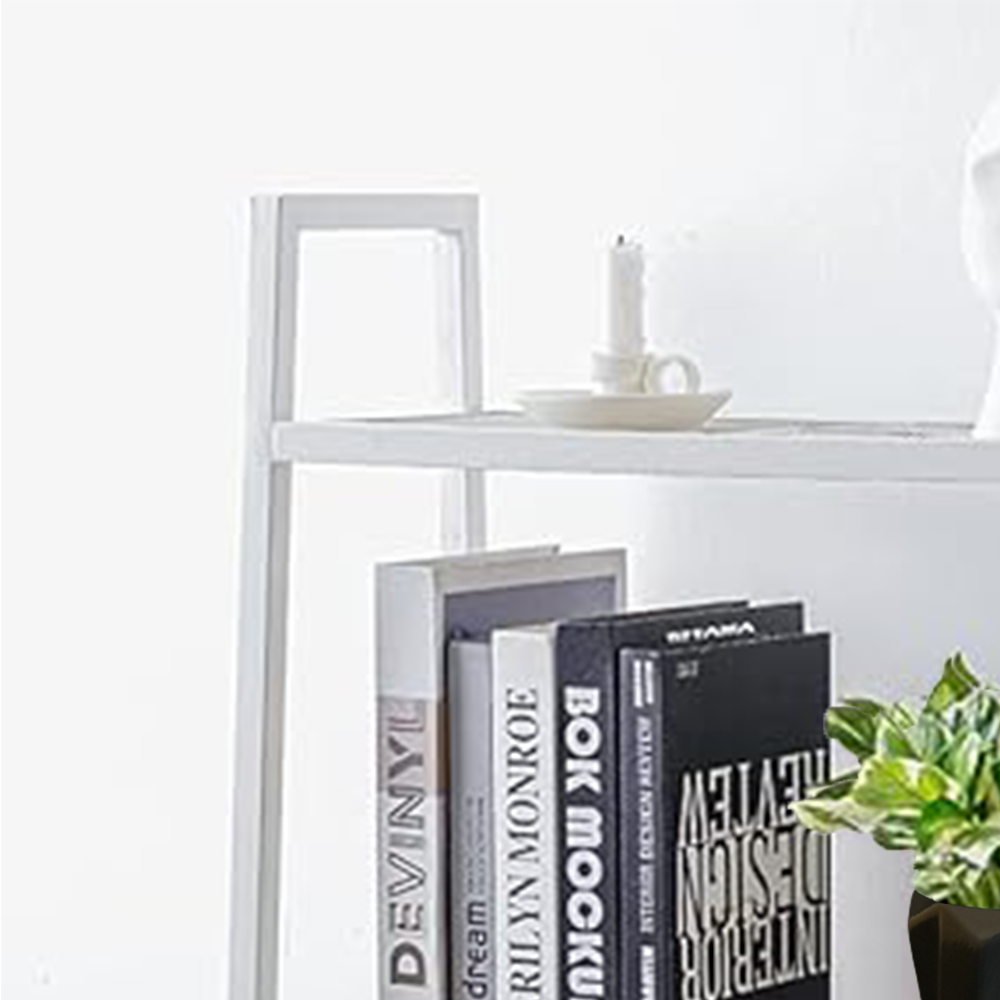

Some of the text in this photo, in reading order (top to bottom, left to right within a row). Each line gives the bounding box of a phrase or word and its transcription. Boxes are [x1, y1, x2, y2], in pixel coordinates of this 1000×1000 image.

[506, 687, 541, 864] MONROE
[564, 686, 602, 794] BOK
[386, 702, 428, 986] DEVINYL
[676, 828, 828, 939] DESIGN
[461, 901, 489, 1000] dream
